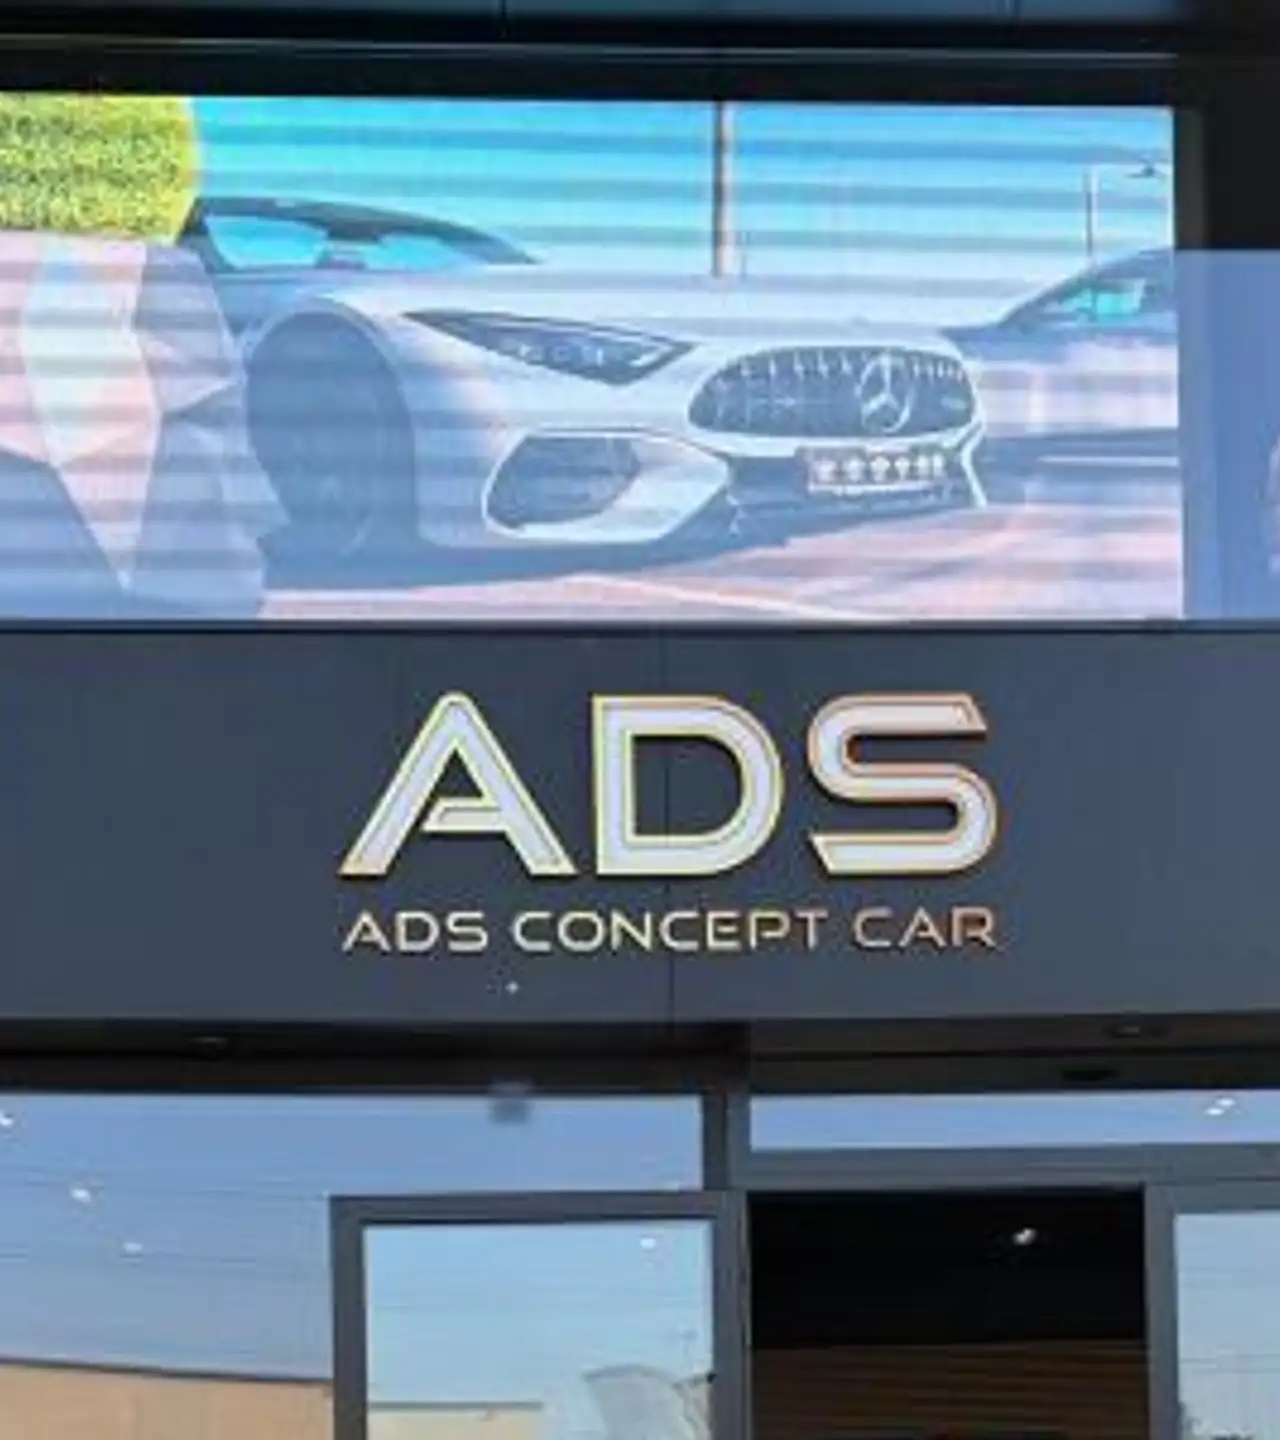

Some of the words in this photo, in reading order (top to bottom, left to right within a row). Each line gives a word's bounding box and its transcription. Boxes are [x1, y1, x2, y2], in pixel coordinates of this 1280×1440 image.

[337, 692, 998, 876] ADS
[342, 909, 489, 953] ADS
[511, 908, 828, 952] CONCEPT
[852, 906, 998, 950] CAR
